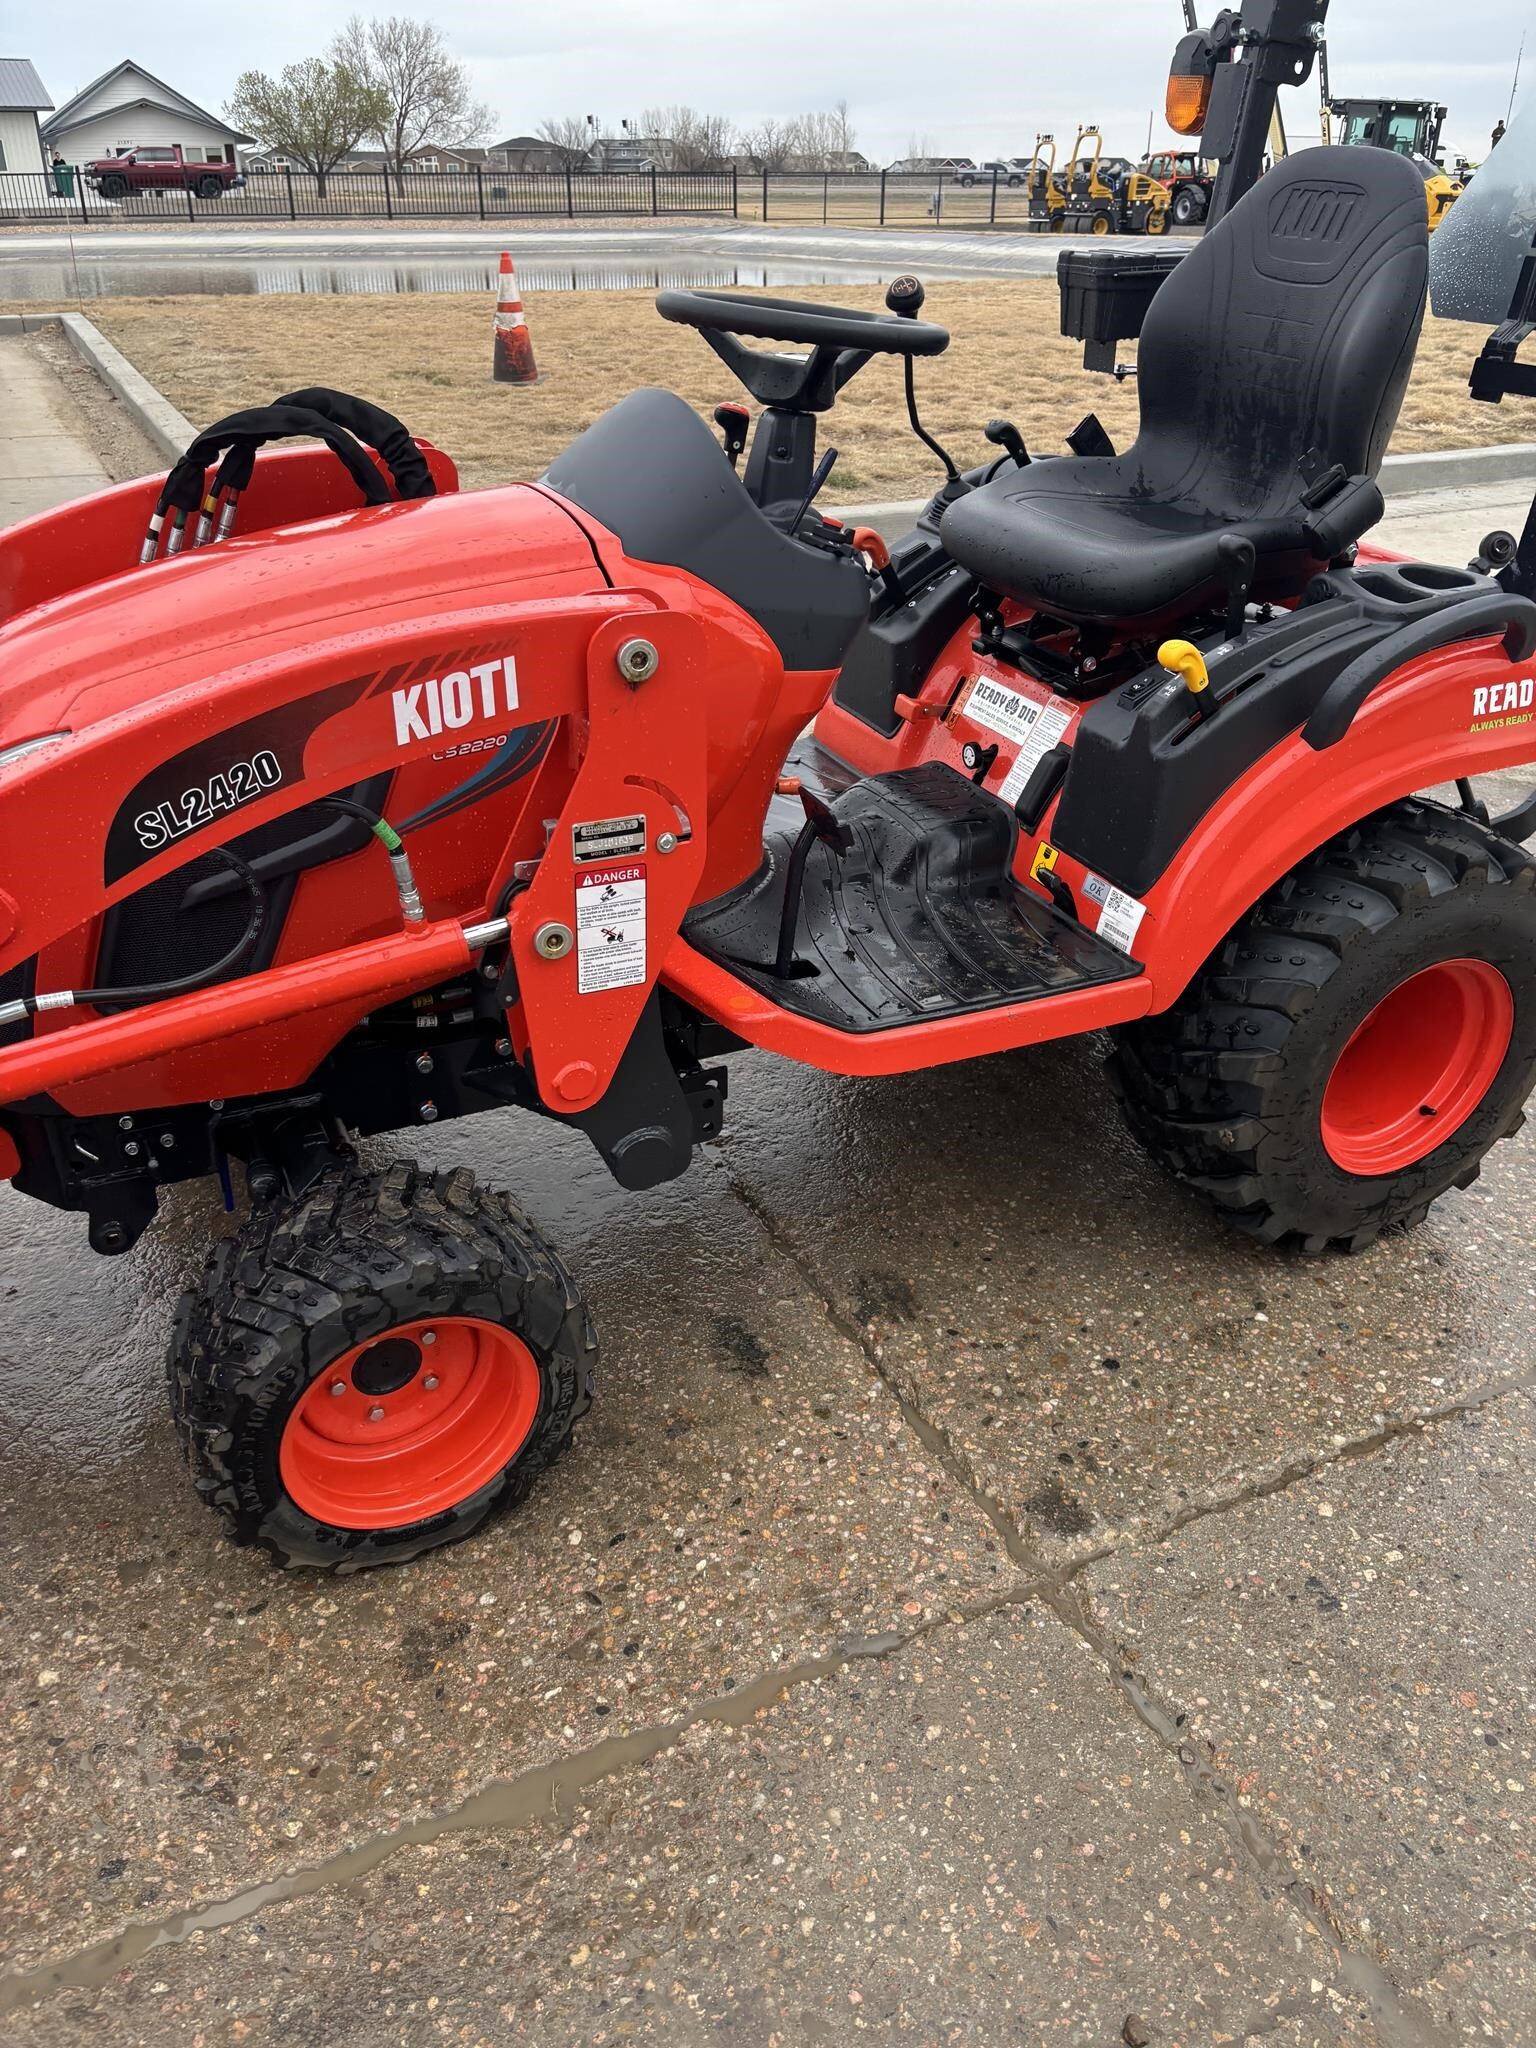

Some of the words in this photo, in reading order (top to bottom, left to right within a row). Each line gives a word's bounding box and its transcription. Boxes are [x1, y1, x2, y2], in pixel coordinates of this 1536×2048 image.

[392, 655, 519, 746] KIOTI
[975, 683, 1007, 708] READY
[1017, 704, 1038, 724] DIG
[1473, 678, 1536, 716] READ
[1470, 718, 1505, 733] ALWAYS
[1506, 713, 1534, 726] READY
[134, 750, 282, 849] SL2420
[594, 868, 640, 884] DANGER
[1089, 882, 1104, 896] OK
